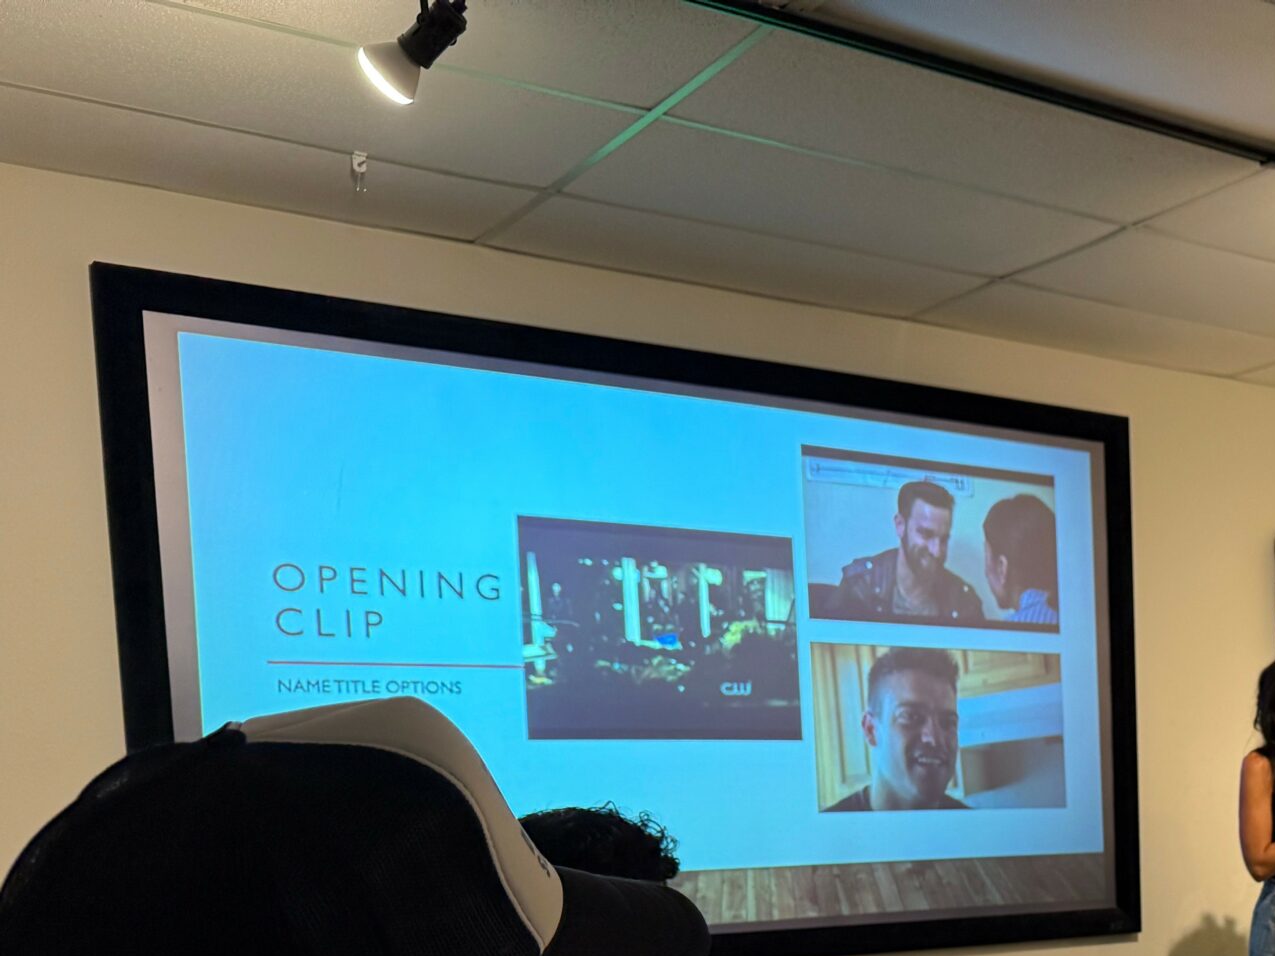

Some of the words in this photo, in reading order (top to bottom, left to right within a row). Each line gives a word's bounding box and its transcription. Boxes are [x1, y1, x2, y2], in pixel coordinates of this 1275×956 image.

[273, 563, 500, 600] OPENING
[275, 608, 383, 638] CLIP
[386, 680, 462, 695] OPTIONS
